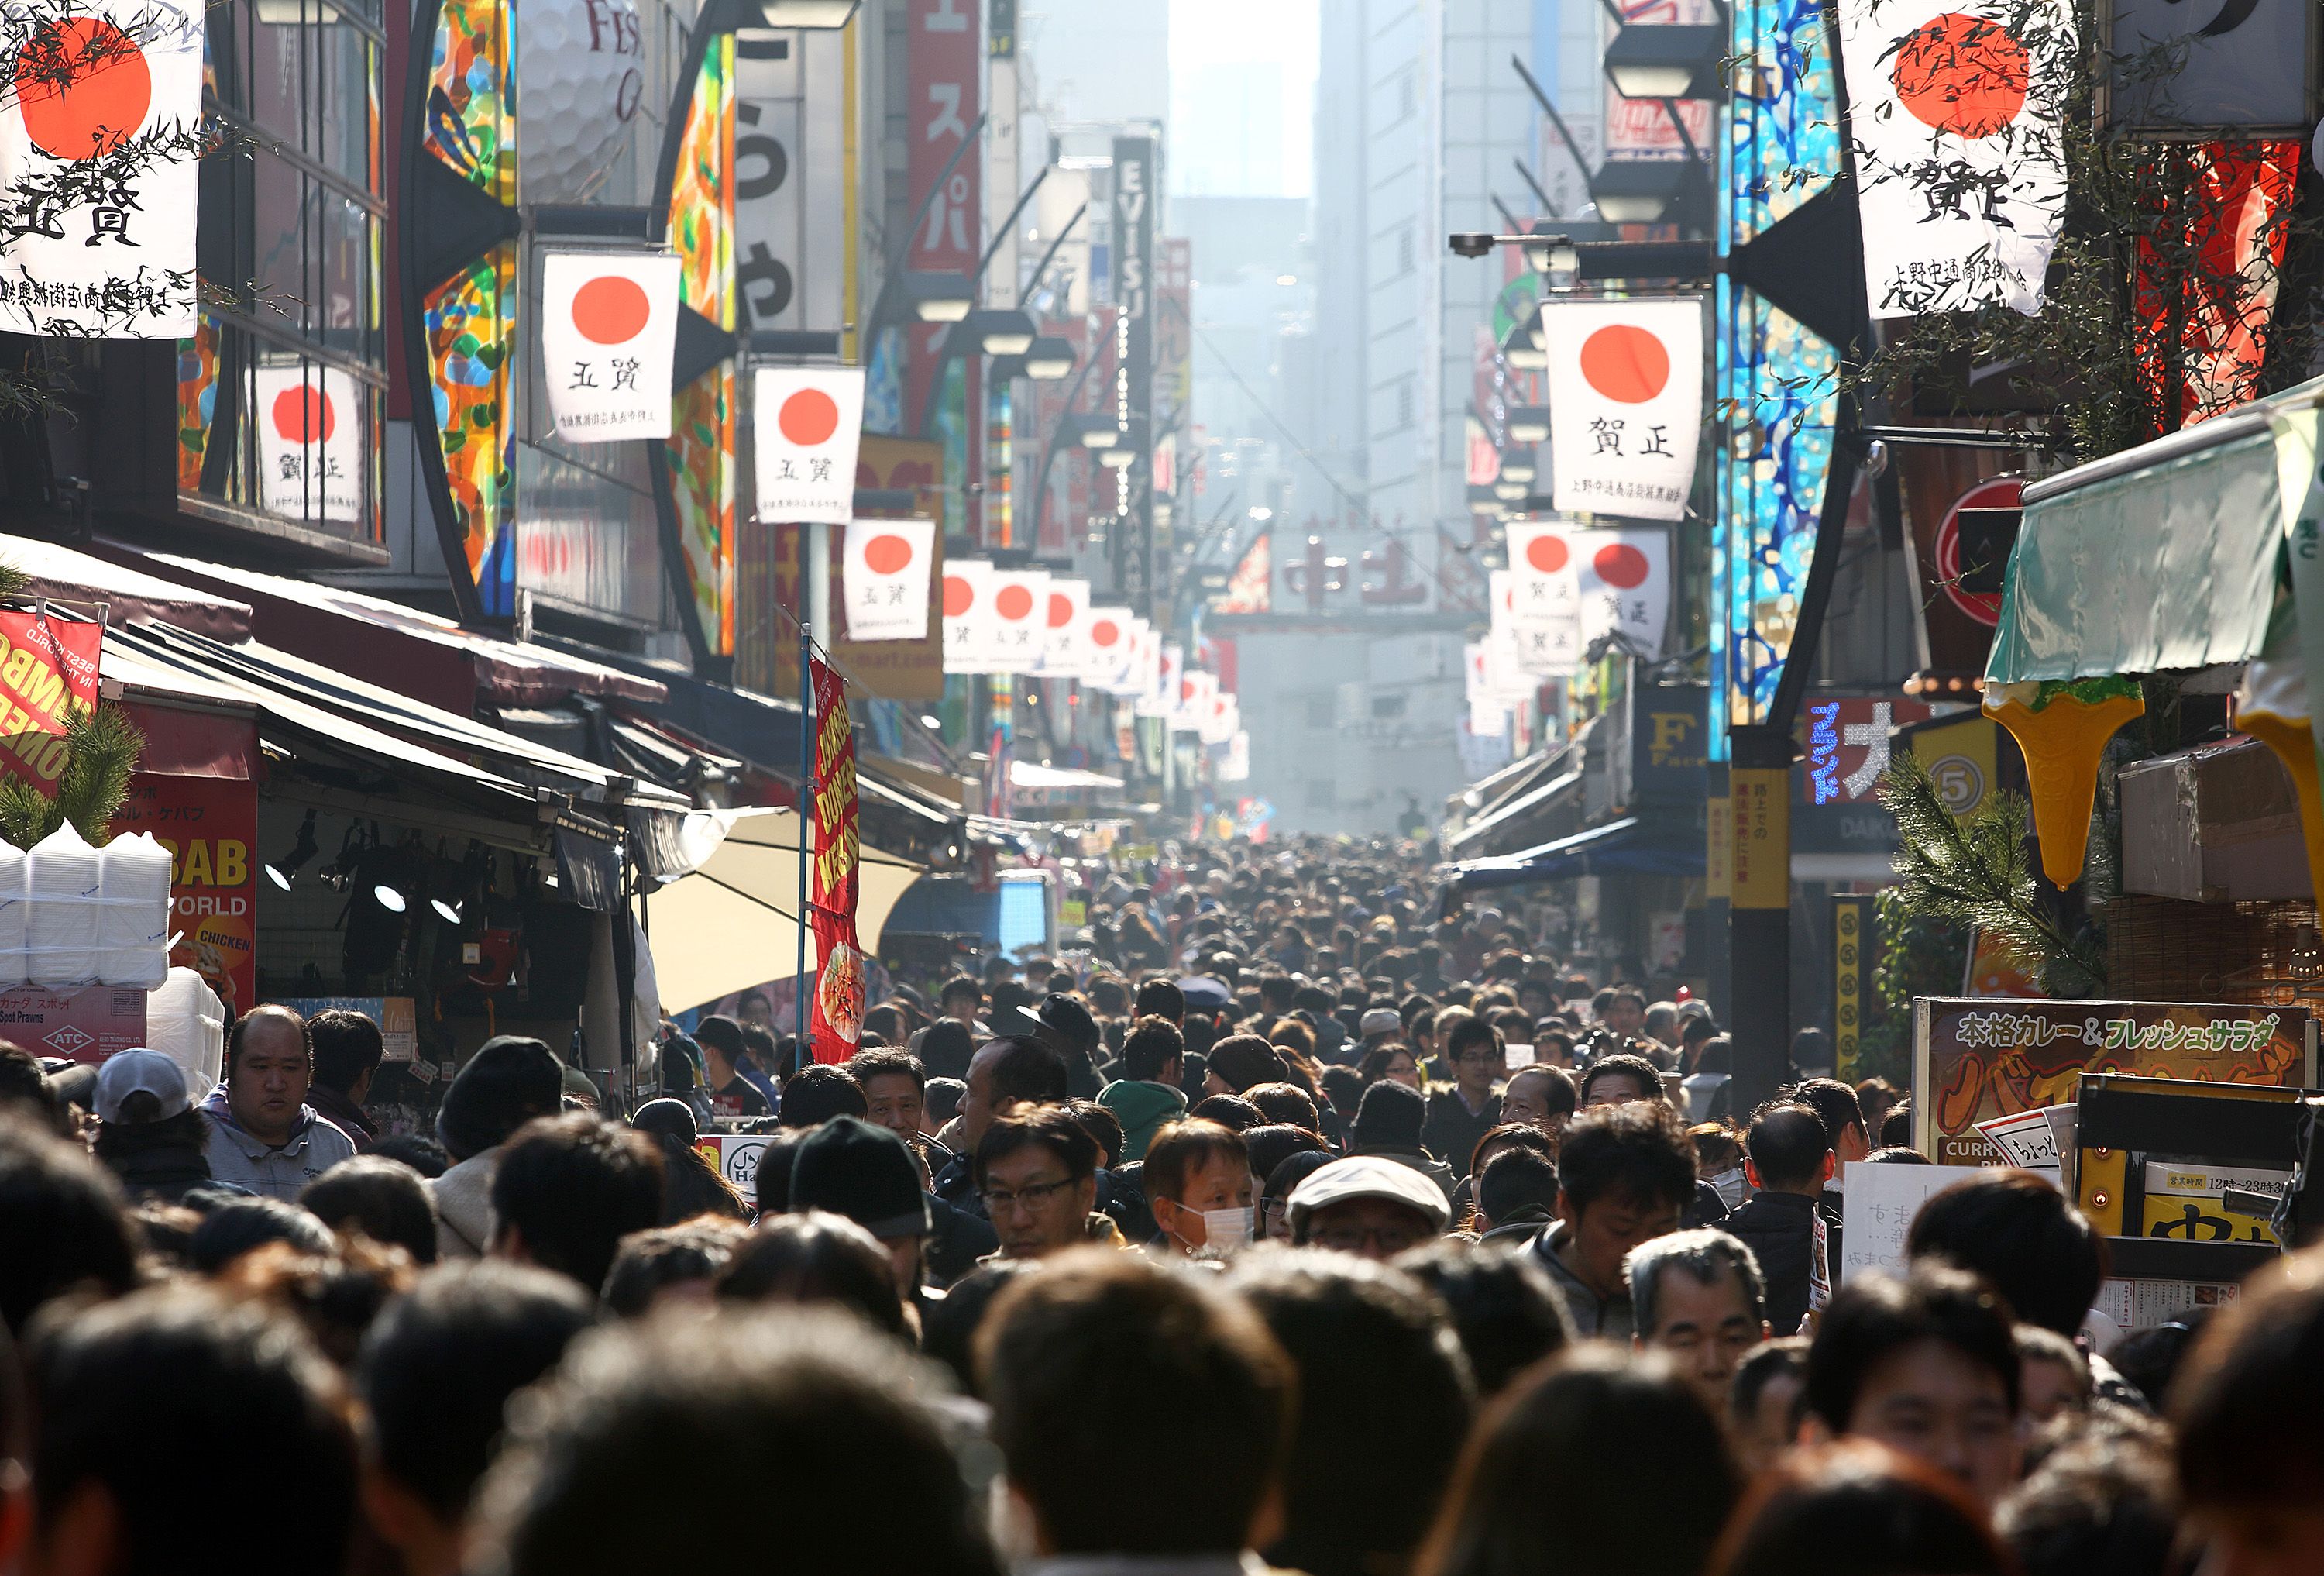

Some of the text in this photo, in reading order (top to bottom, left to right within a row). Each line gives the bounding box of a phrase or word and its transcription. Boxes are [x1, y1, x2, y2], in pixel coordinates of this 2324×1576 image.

[1117, 160, 1146, 319] EVISU
[1588, 417, 1674, 458] 賀正
[819, 694, 851, 777] JUMBO
[1649, 713, 1698, 751] F
[816, 755, 858, 835] DONER
[155, 838, 247, 886] BAB
[200, 930, 251, 952] CHICKEN
[0, 997, 31, 1009] カナダ
[0, 1010, 44, 1025] Spot Prawns
[54, 1034, 83, 1044] ATC
[2170, 1176, 2203, 1187] 営業時間
